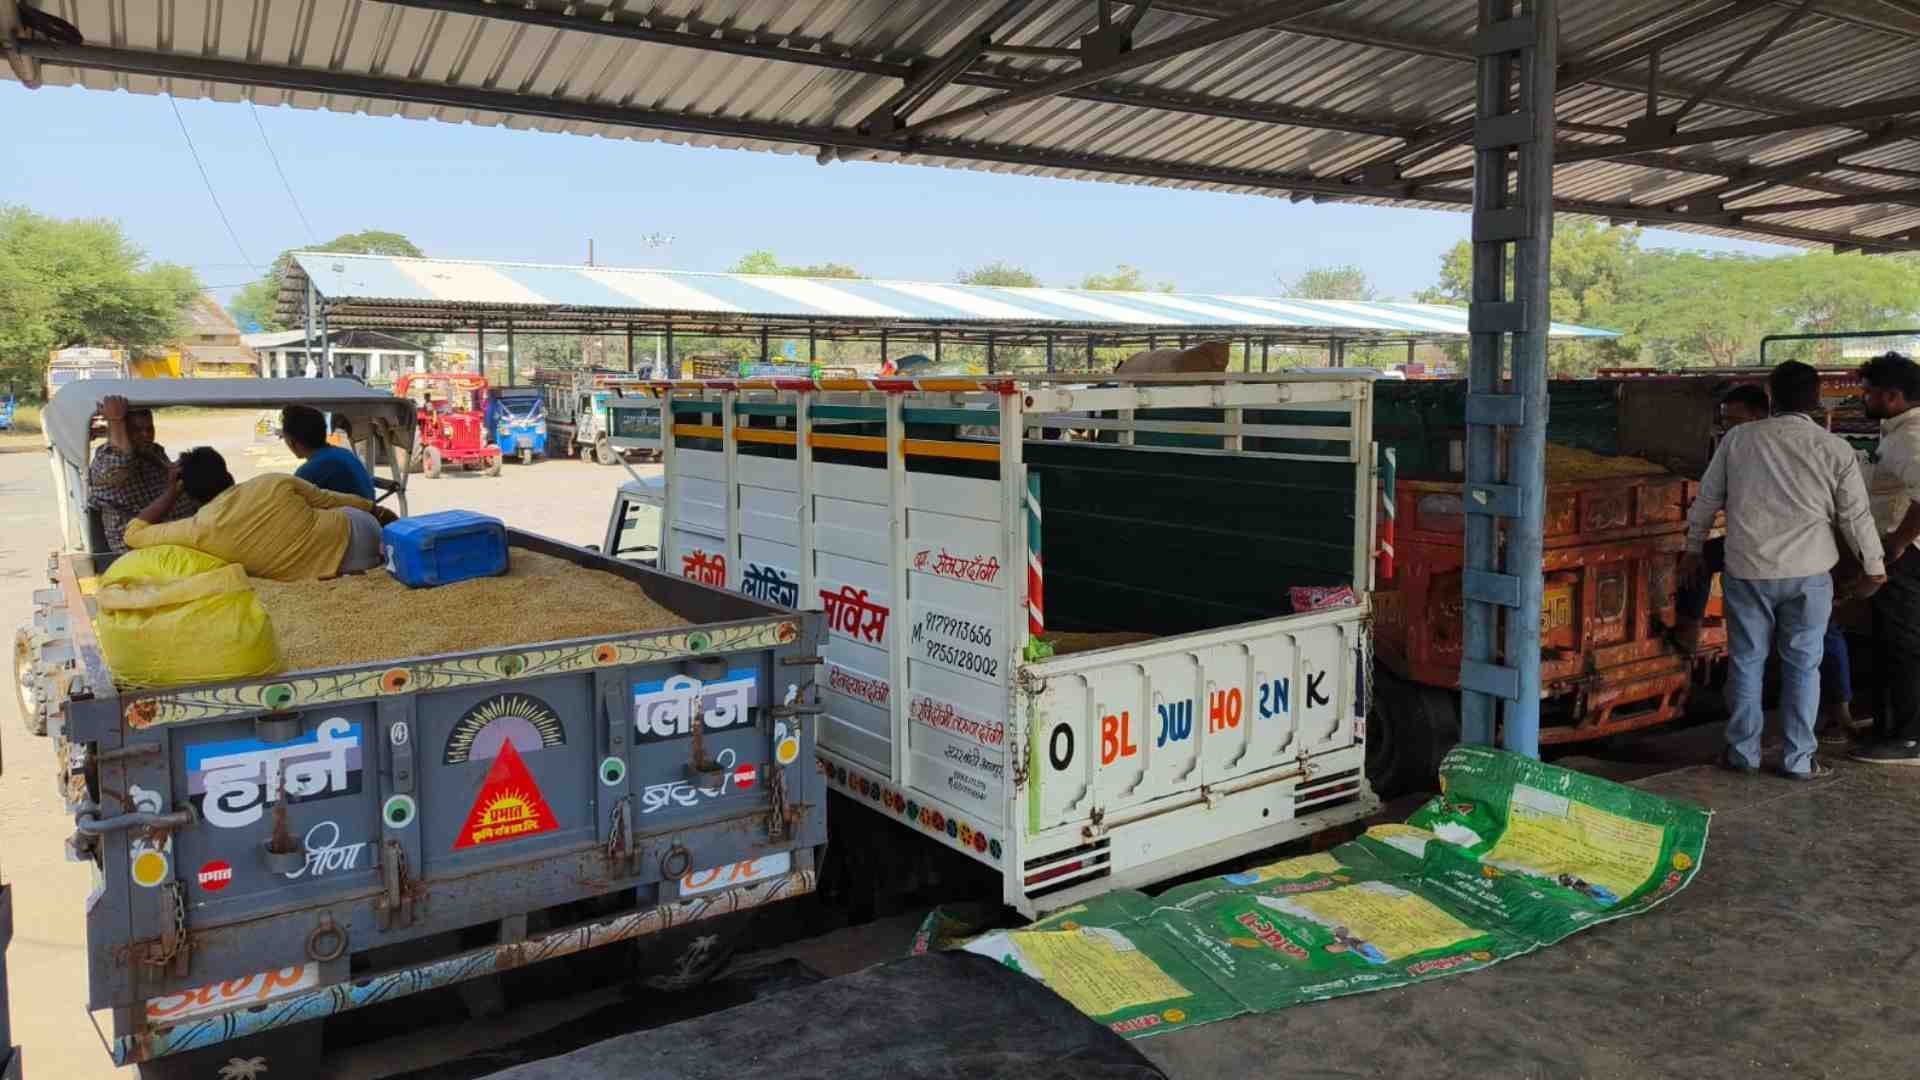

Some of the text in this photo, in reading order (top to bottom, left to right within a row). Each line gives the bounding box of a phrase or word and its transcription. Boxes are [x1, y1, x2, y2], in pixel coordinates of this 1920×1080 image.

[740, 563, 799, 609] लोडिंग
[819, 585, 890, 643] सर्विस
[926, 611, 992, 647] 9179913656
[927, 640, 999, 678] 9755128002
[200, 717, 358, 828] हार्न
[633, 674, 758, 737] प्लीज
[1049, 722, 1075, 771] O
[1306, 670, 1330, 709] K
